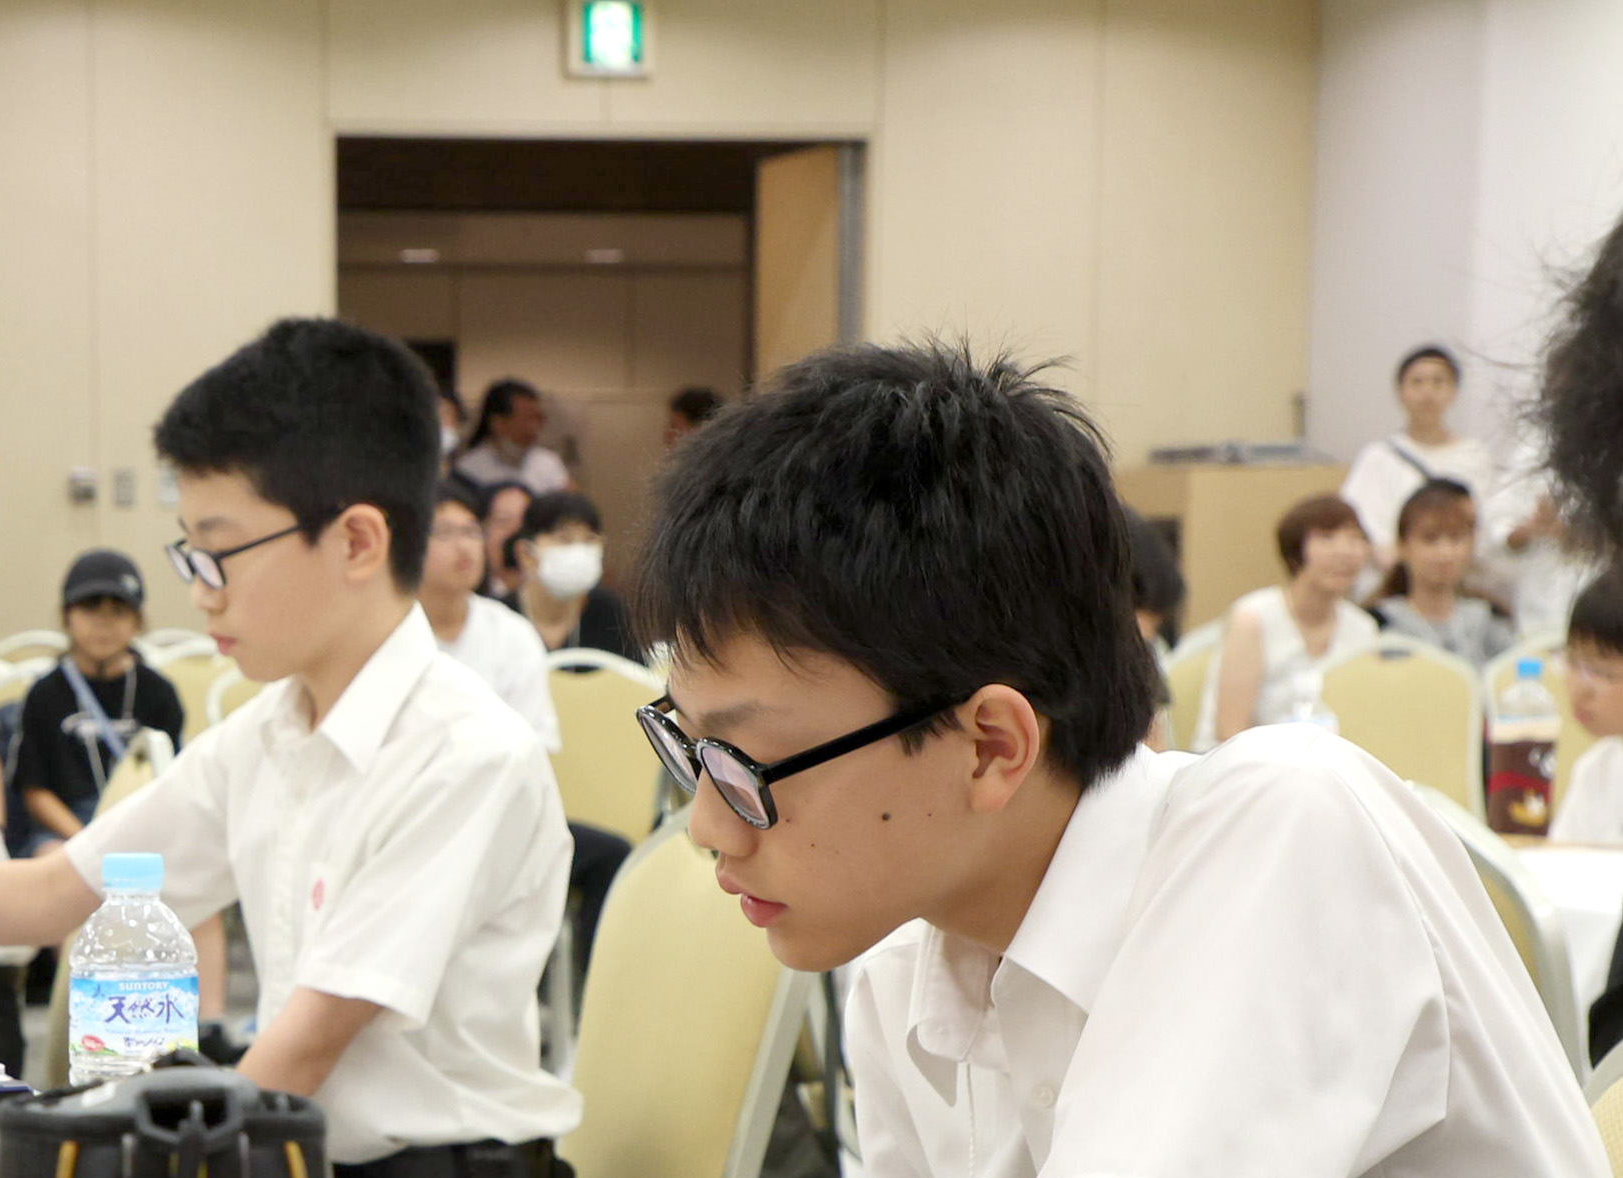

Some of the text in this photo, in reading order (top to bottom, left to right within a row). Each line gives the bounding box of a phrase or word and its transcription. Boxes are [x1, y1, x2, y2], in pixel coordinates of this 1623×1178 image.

[119, 981, 170, 992] SUNTORY
[104, 993, 185, 1024] 天然水
